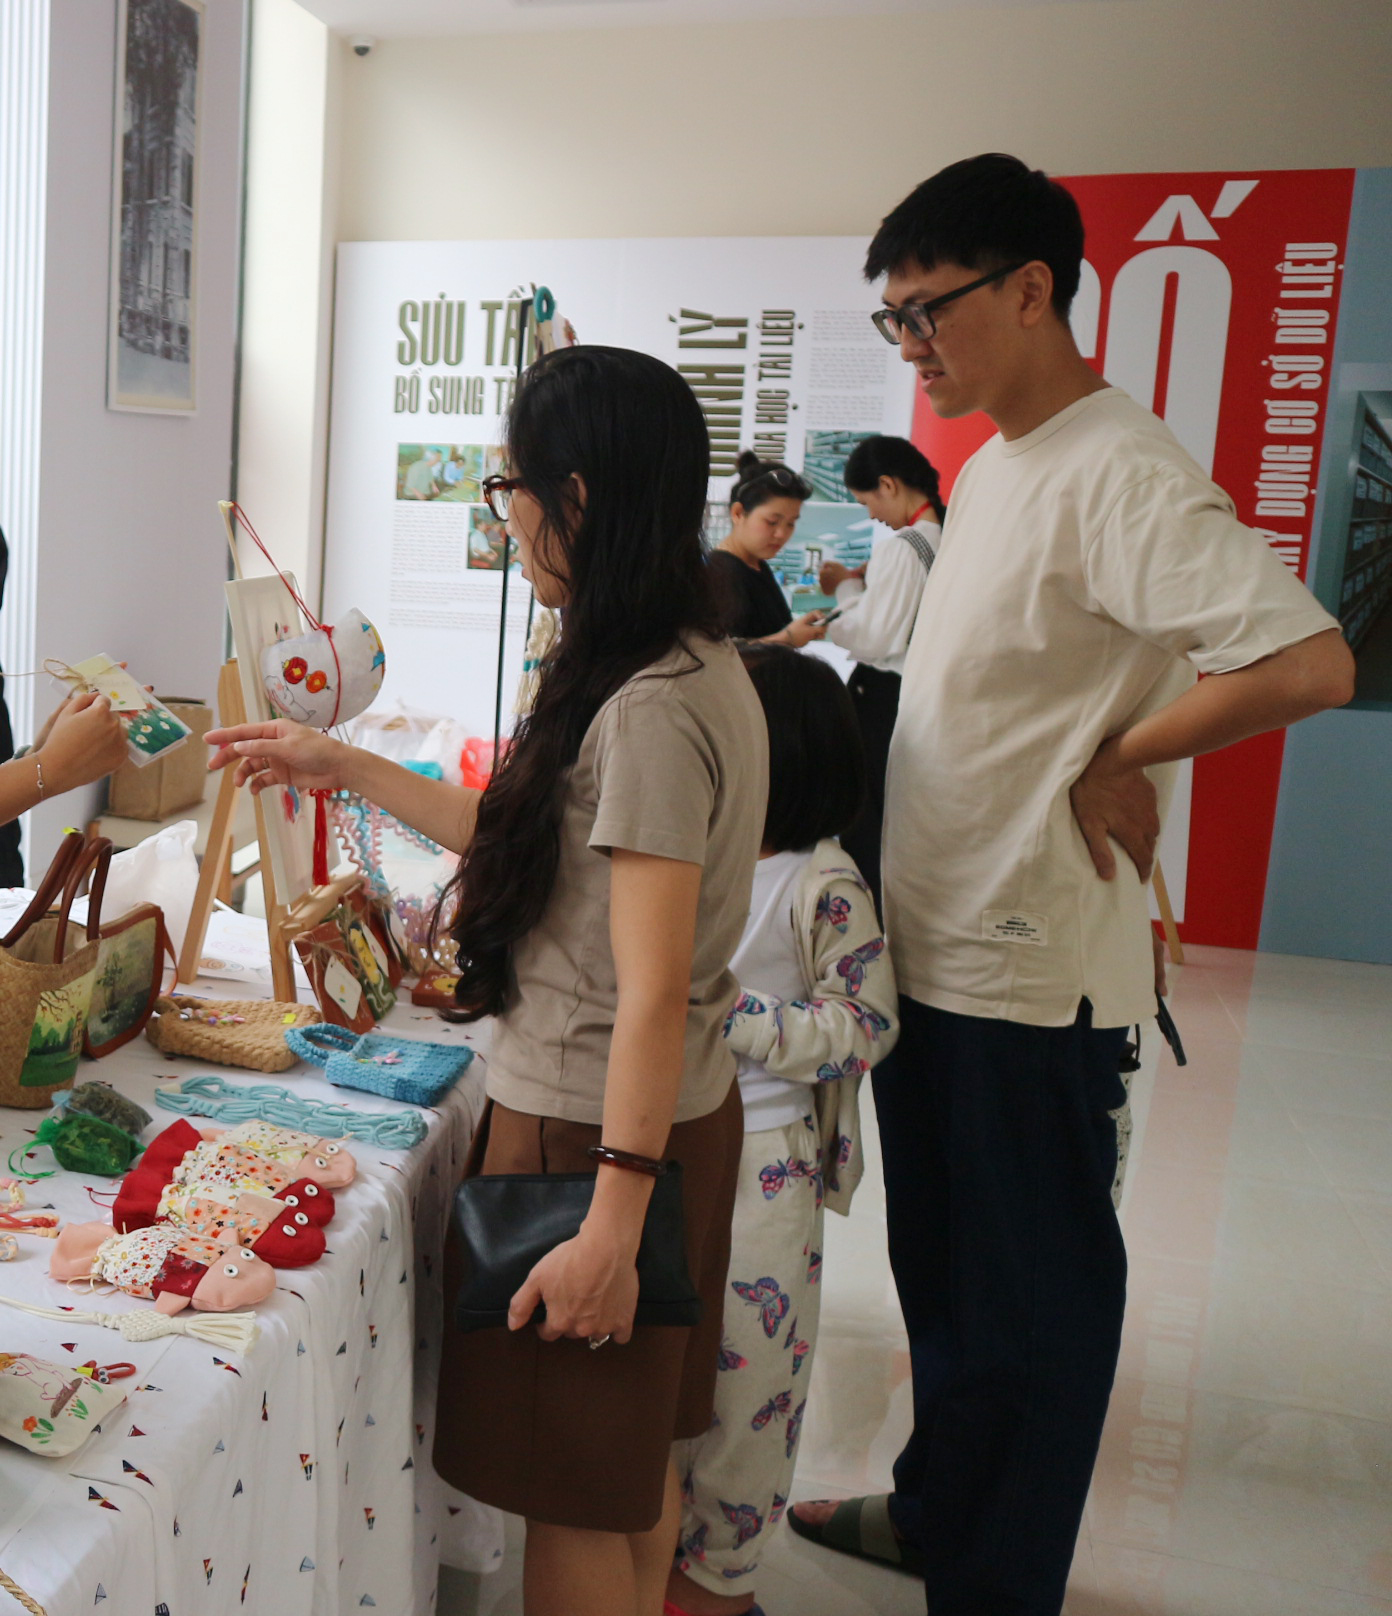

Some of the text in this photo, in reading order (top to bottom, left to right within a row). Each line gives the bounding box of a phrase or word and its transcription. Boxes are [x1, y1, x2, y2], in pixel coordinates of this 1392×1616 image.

[1275, 241, 1345, 298] LIỆU
[1270, 306, 1331, 343] DỮ
[752, 308, 804, 464] HOA HỌC TÀI LIỆU
[1261, 353, 1325, 389] SỞ
[428, 375, 485, 415] SUNG
[1263, 398, 1319, 434] CƠ
[1254, 444, 1317, 516] DỰNG
